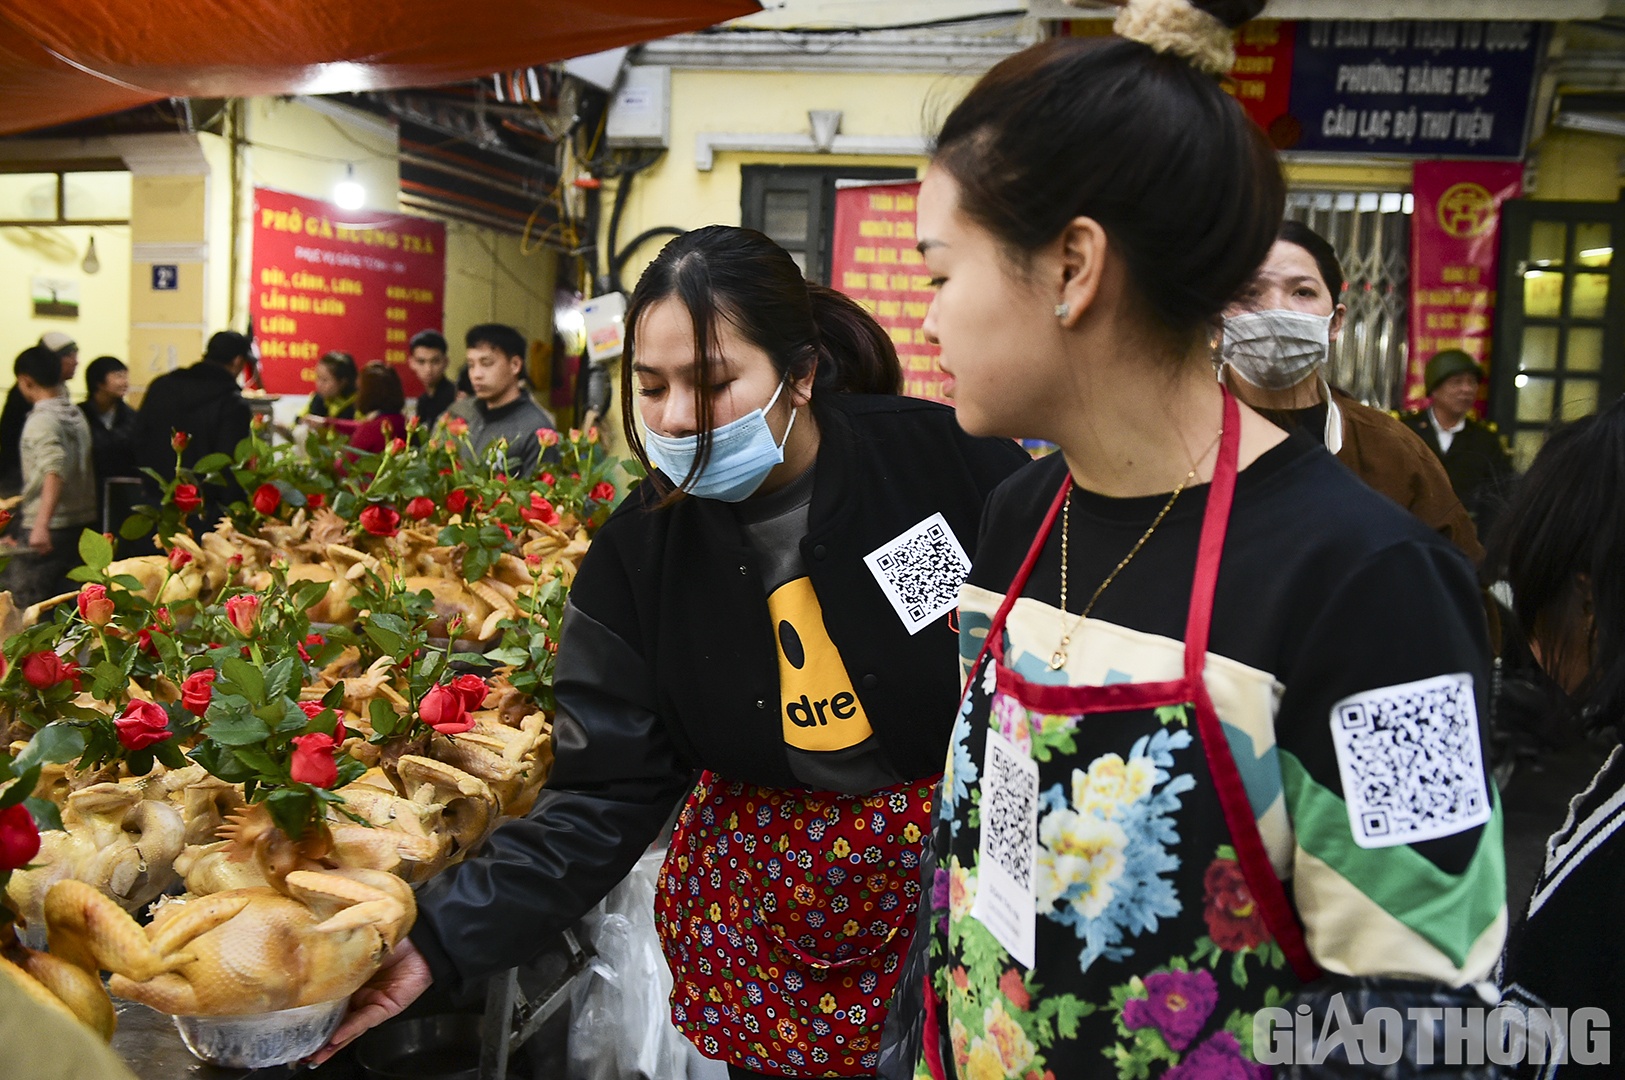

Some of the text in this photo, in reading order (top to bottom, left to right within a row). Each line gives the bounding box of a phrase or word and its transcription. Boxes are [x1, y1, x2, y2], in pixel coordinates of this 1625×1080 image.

[1406, 60, 1454, 95] HÀNG
[1455, 66, 1491, 102] BẠC
[1358, 110, 1392, 144] LẠC
[1392, 105, 1417, 144] BỘ
[1418, 109, 1454, 139] THƯ
[1454, 106, 1494, 147] VIỆN
[262, 206, 302, 233] PHỞ
[305, 216, 333, 239] GÀ
